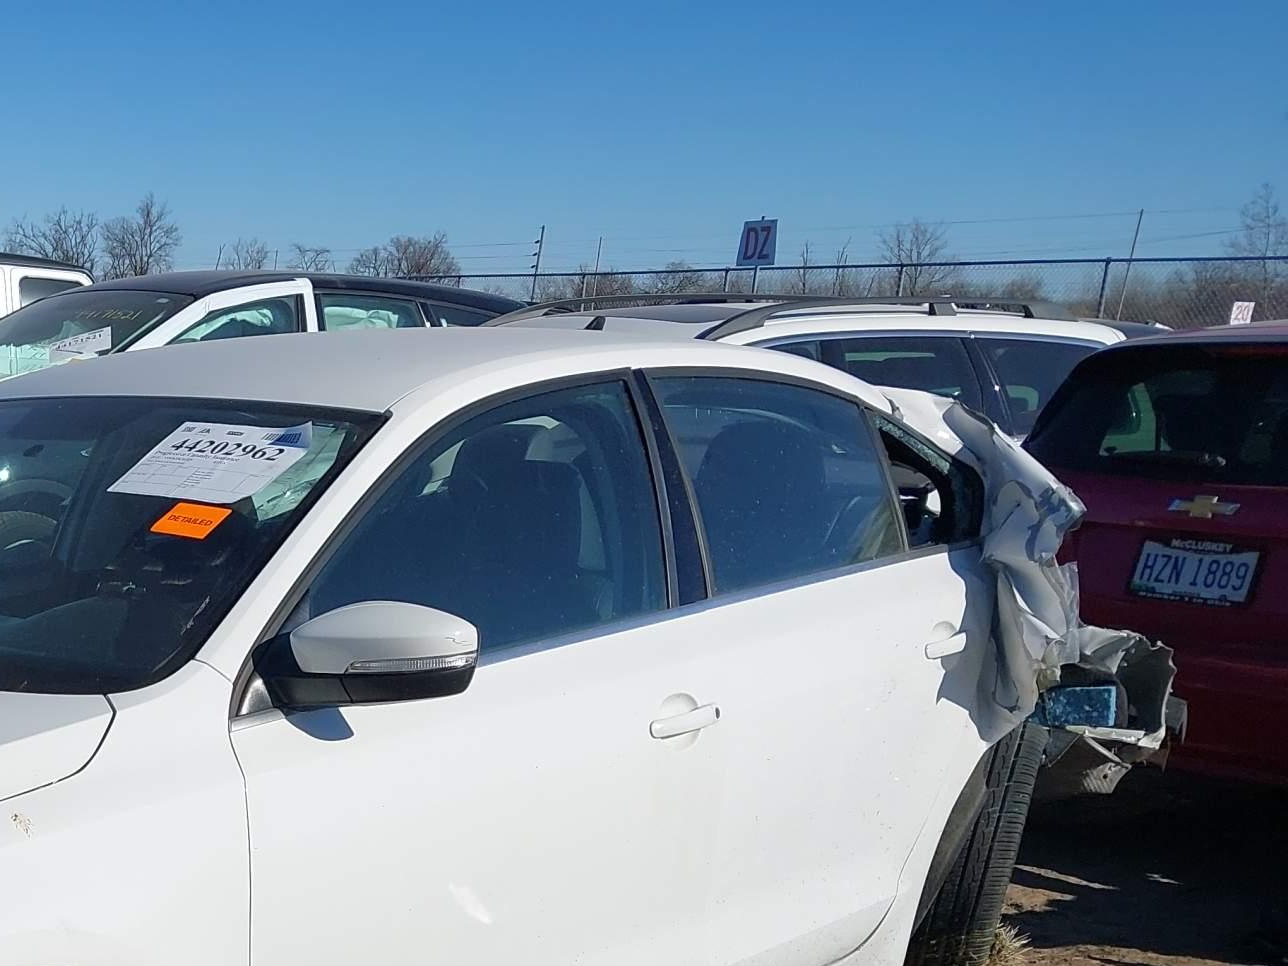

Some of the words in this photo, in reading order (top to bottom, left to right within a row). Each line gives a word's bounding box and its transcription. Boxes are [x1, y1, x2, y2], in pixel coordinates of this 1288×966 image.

[172, 438, 285, 461] 44202962
[167, 514, 213, 527] DETAILED
[1139, 552, 1186, 585] HZN
[1189, 558, 1250, 591] 1889
